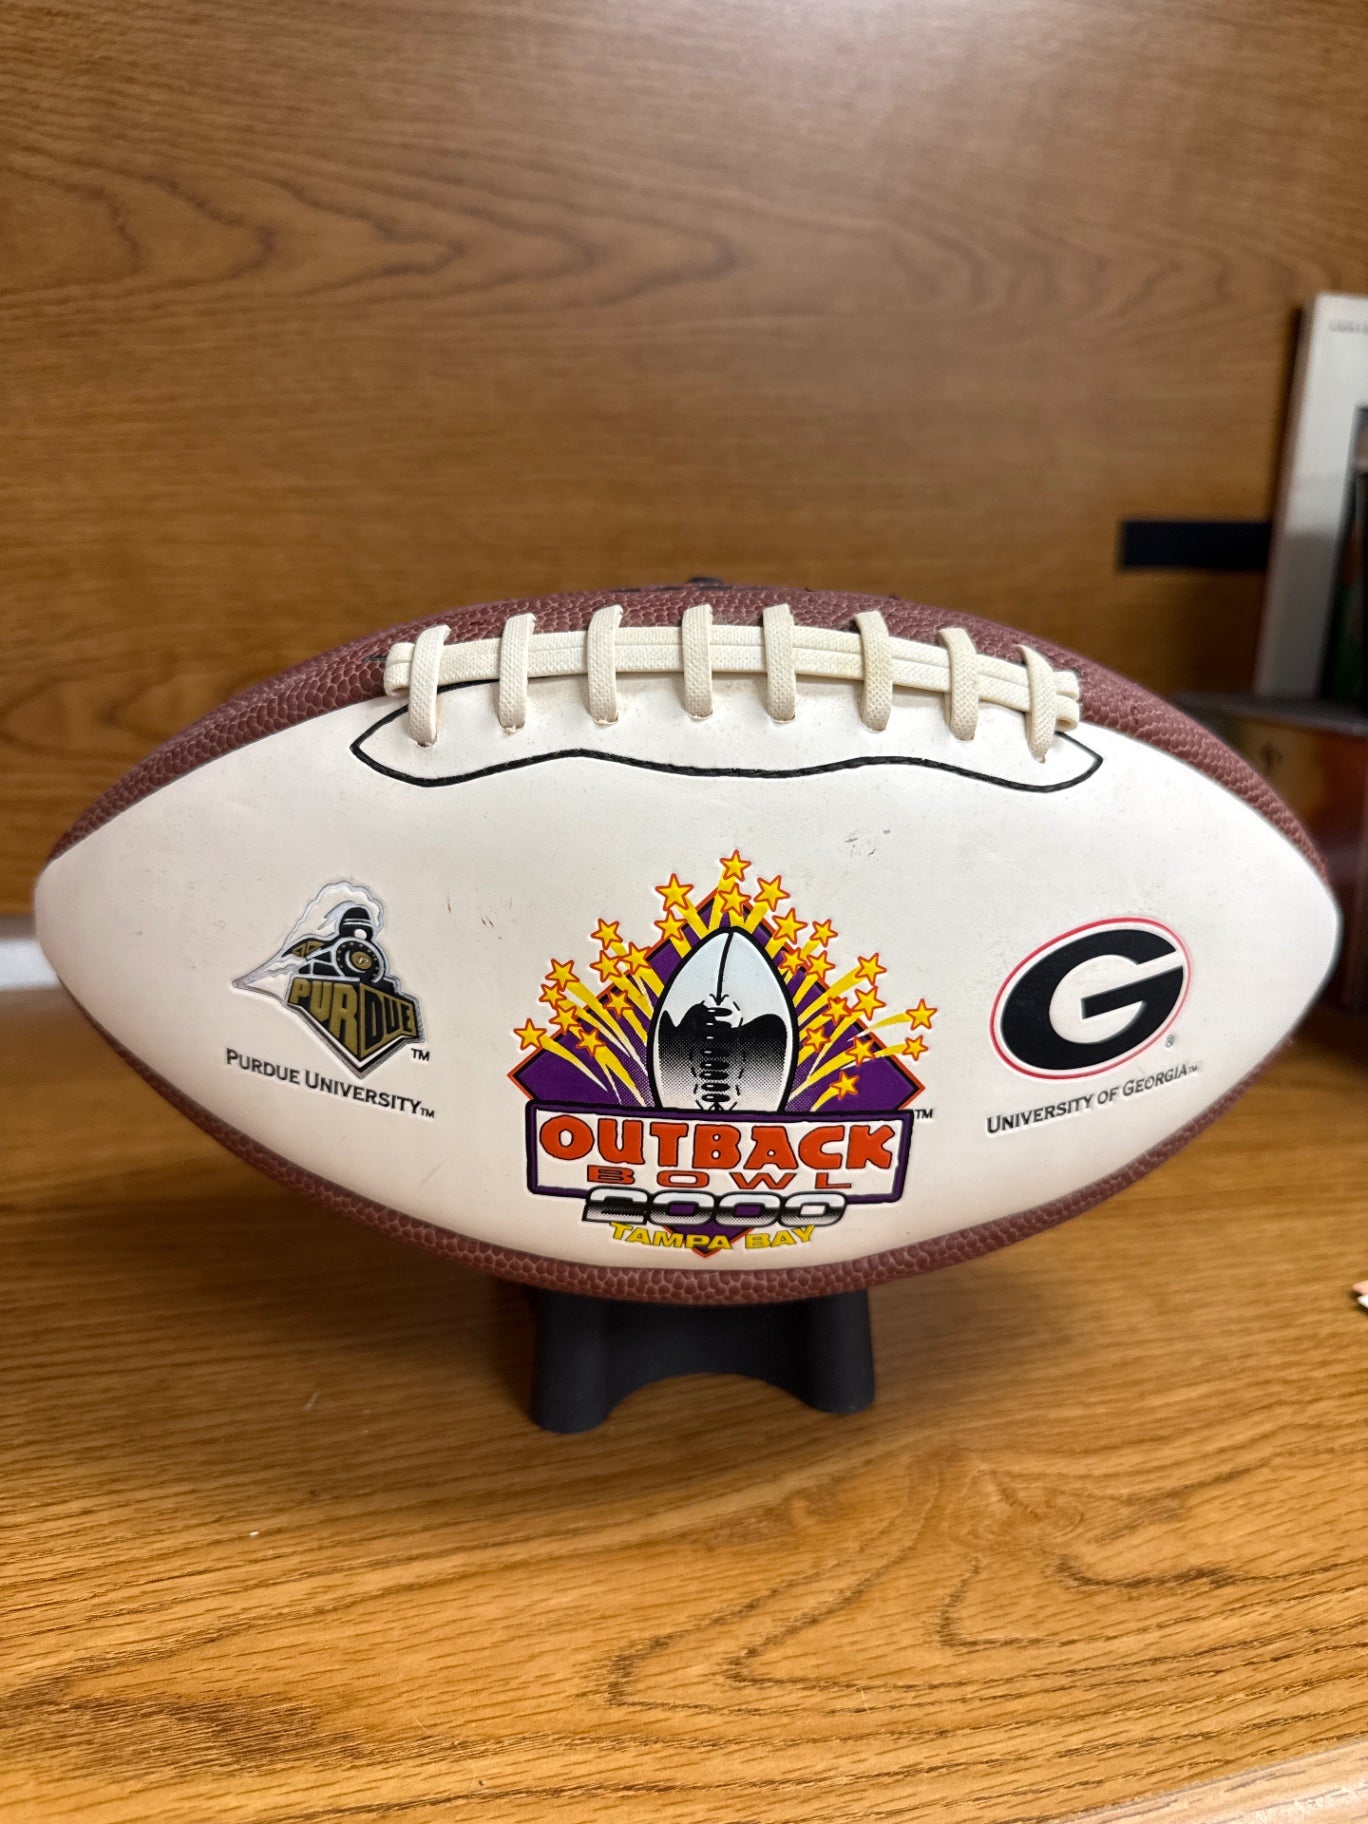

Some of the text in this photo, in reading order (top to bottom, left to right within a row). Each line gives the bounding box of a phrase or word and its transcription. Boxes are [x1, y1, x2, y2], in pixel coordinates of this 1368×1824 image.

[288, 977, 417, 1059] PURDUE
[1000, 929, 1184, 1071] G
[226, 1048, 301, 1085] PURDUE
[986, 1094, 1094, 1134] UNIVERSITY
[1097, 1086, 1120, 1105] OF
[539, 1114, 896, 1170] OUTBACK
[586, 1165, 852, 1190] BOWL
[582, 1186, 848, 1227] 2000
[609, 1222, 816, 1250] TAMPA BAY
